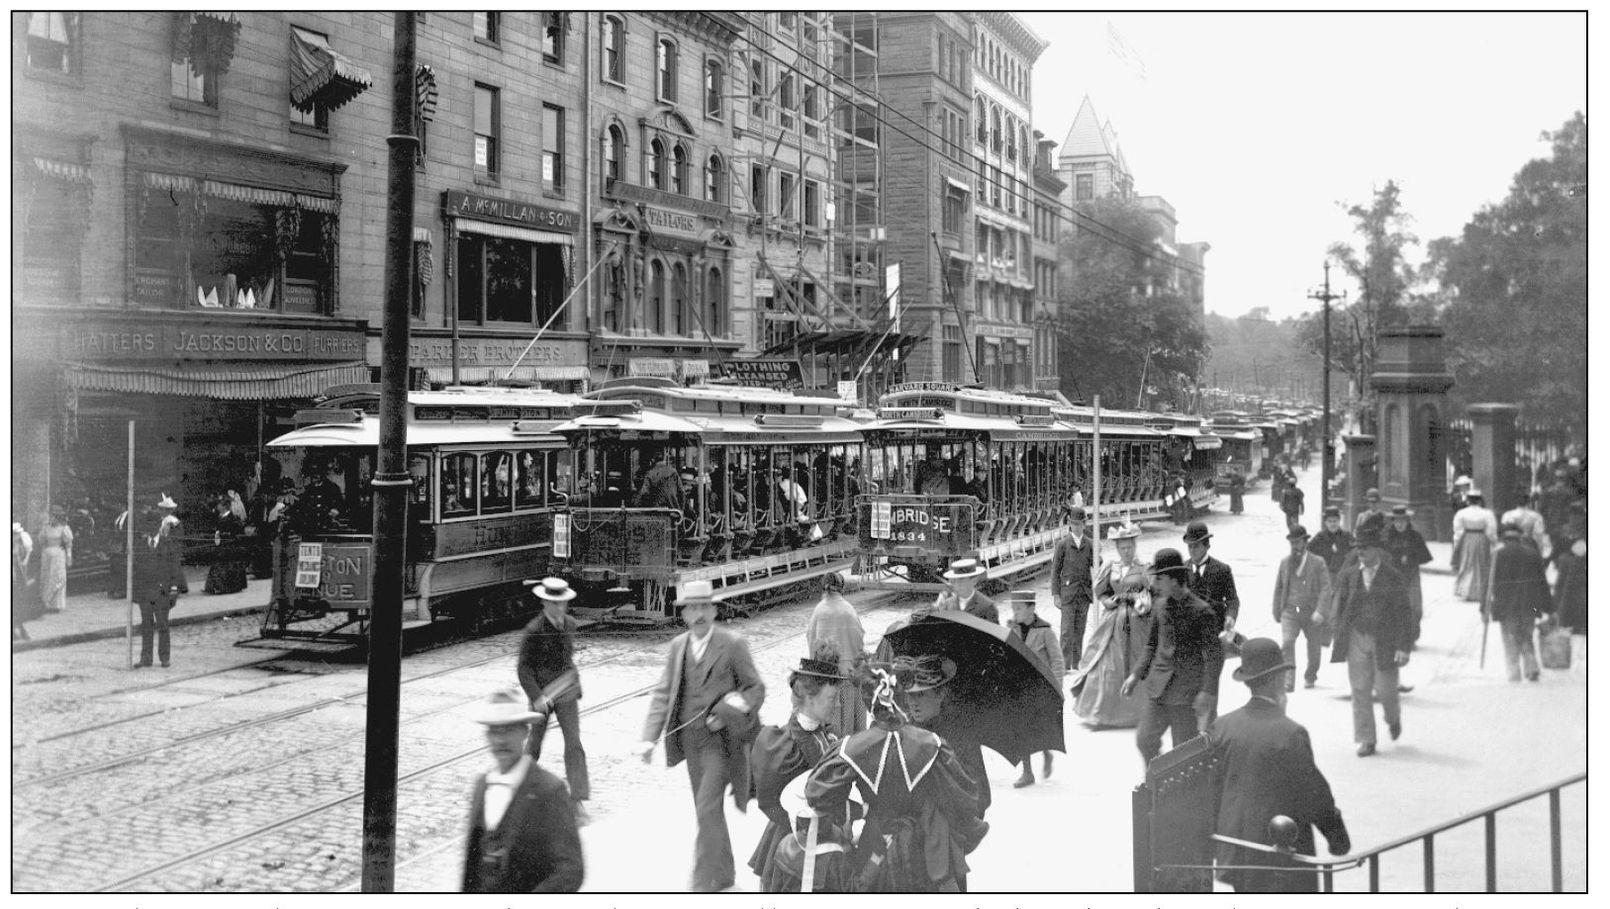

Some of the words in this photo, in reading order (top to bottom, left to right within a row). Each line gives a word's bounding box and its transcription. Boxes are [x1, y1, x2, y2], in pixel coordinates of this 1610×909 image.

[461, 196, 470, 211] A
[548, 211, 572, 227] SON
[648, 208, 695, 232] TAILORS
[75, 330, 155, 352] HATTERS
[174, 332, 259, 351] JACKSON
[313, 336, 360, 353] FURRIERS
[889, 382, 924, 393] HARVARD
[926, 382, 956, 392] SQUARE
[1016, 431, 1061, 440] CAMBRIDGE
